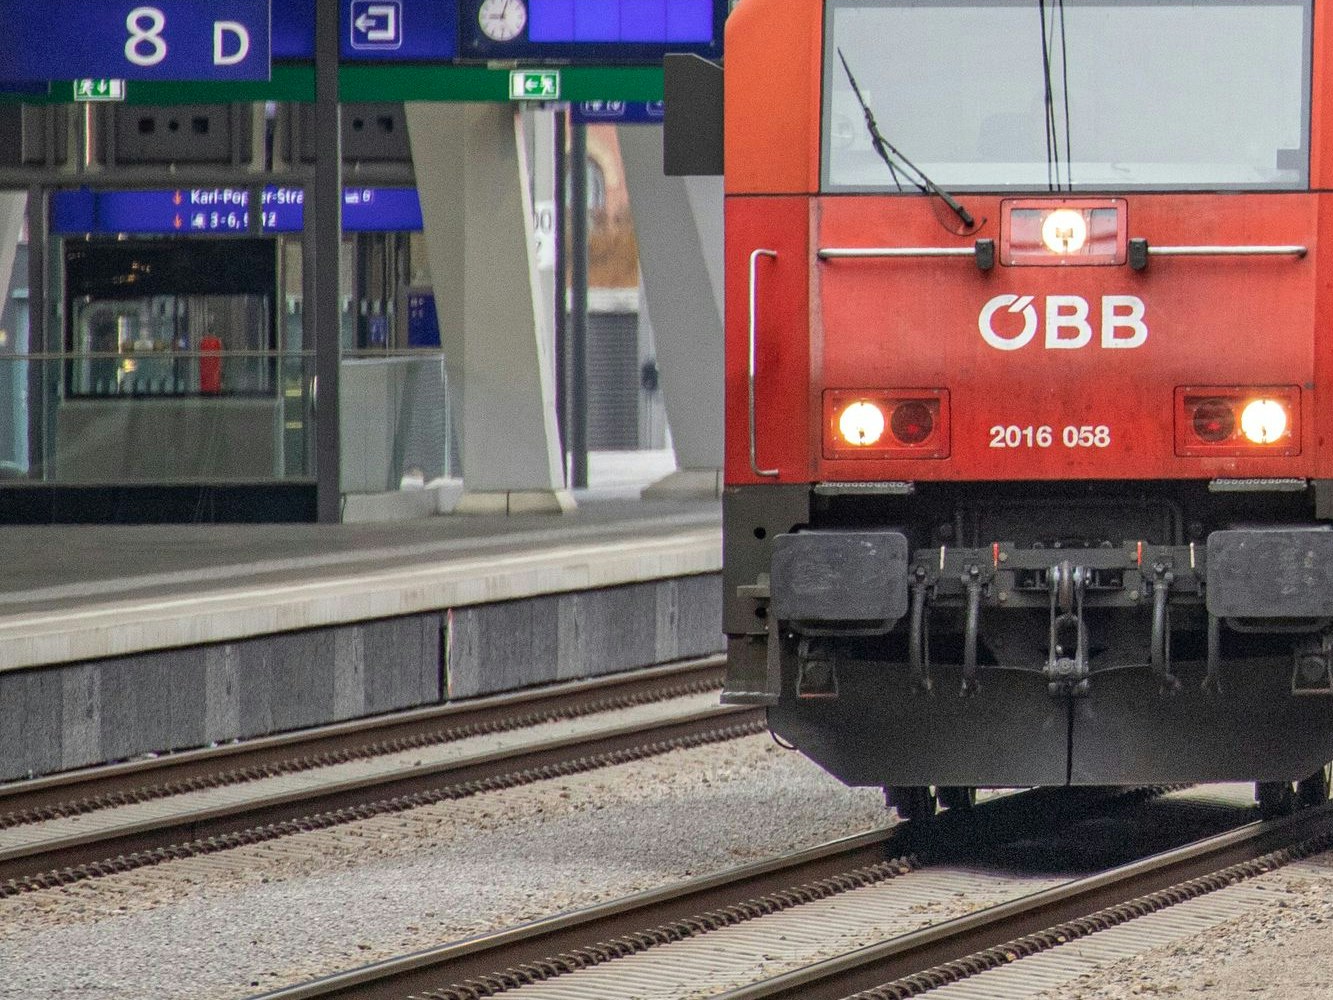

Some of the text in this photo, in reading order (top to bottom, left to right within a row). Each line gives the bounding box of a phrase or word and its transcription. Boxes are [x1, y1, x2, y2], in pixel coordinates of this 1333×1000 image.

[124, 6, 250, 67] 8 D
[978, 294, 1148, 350] ÖBB
[989, 424, 1111, 448] 2016 058
